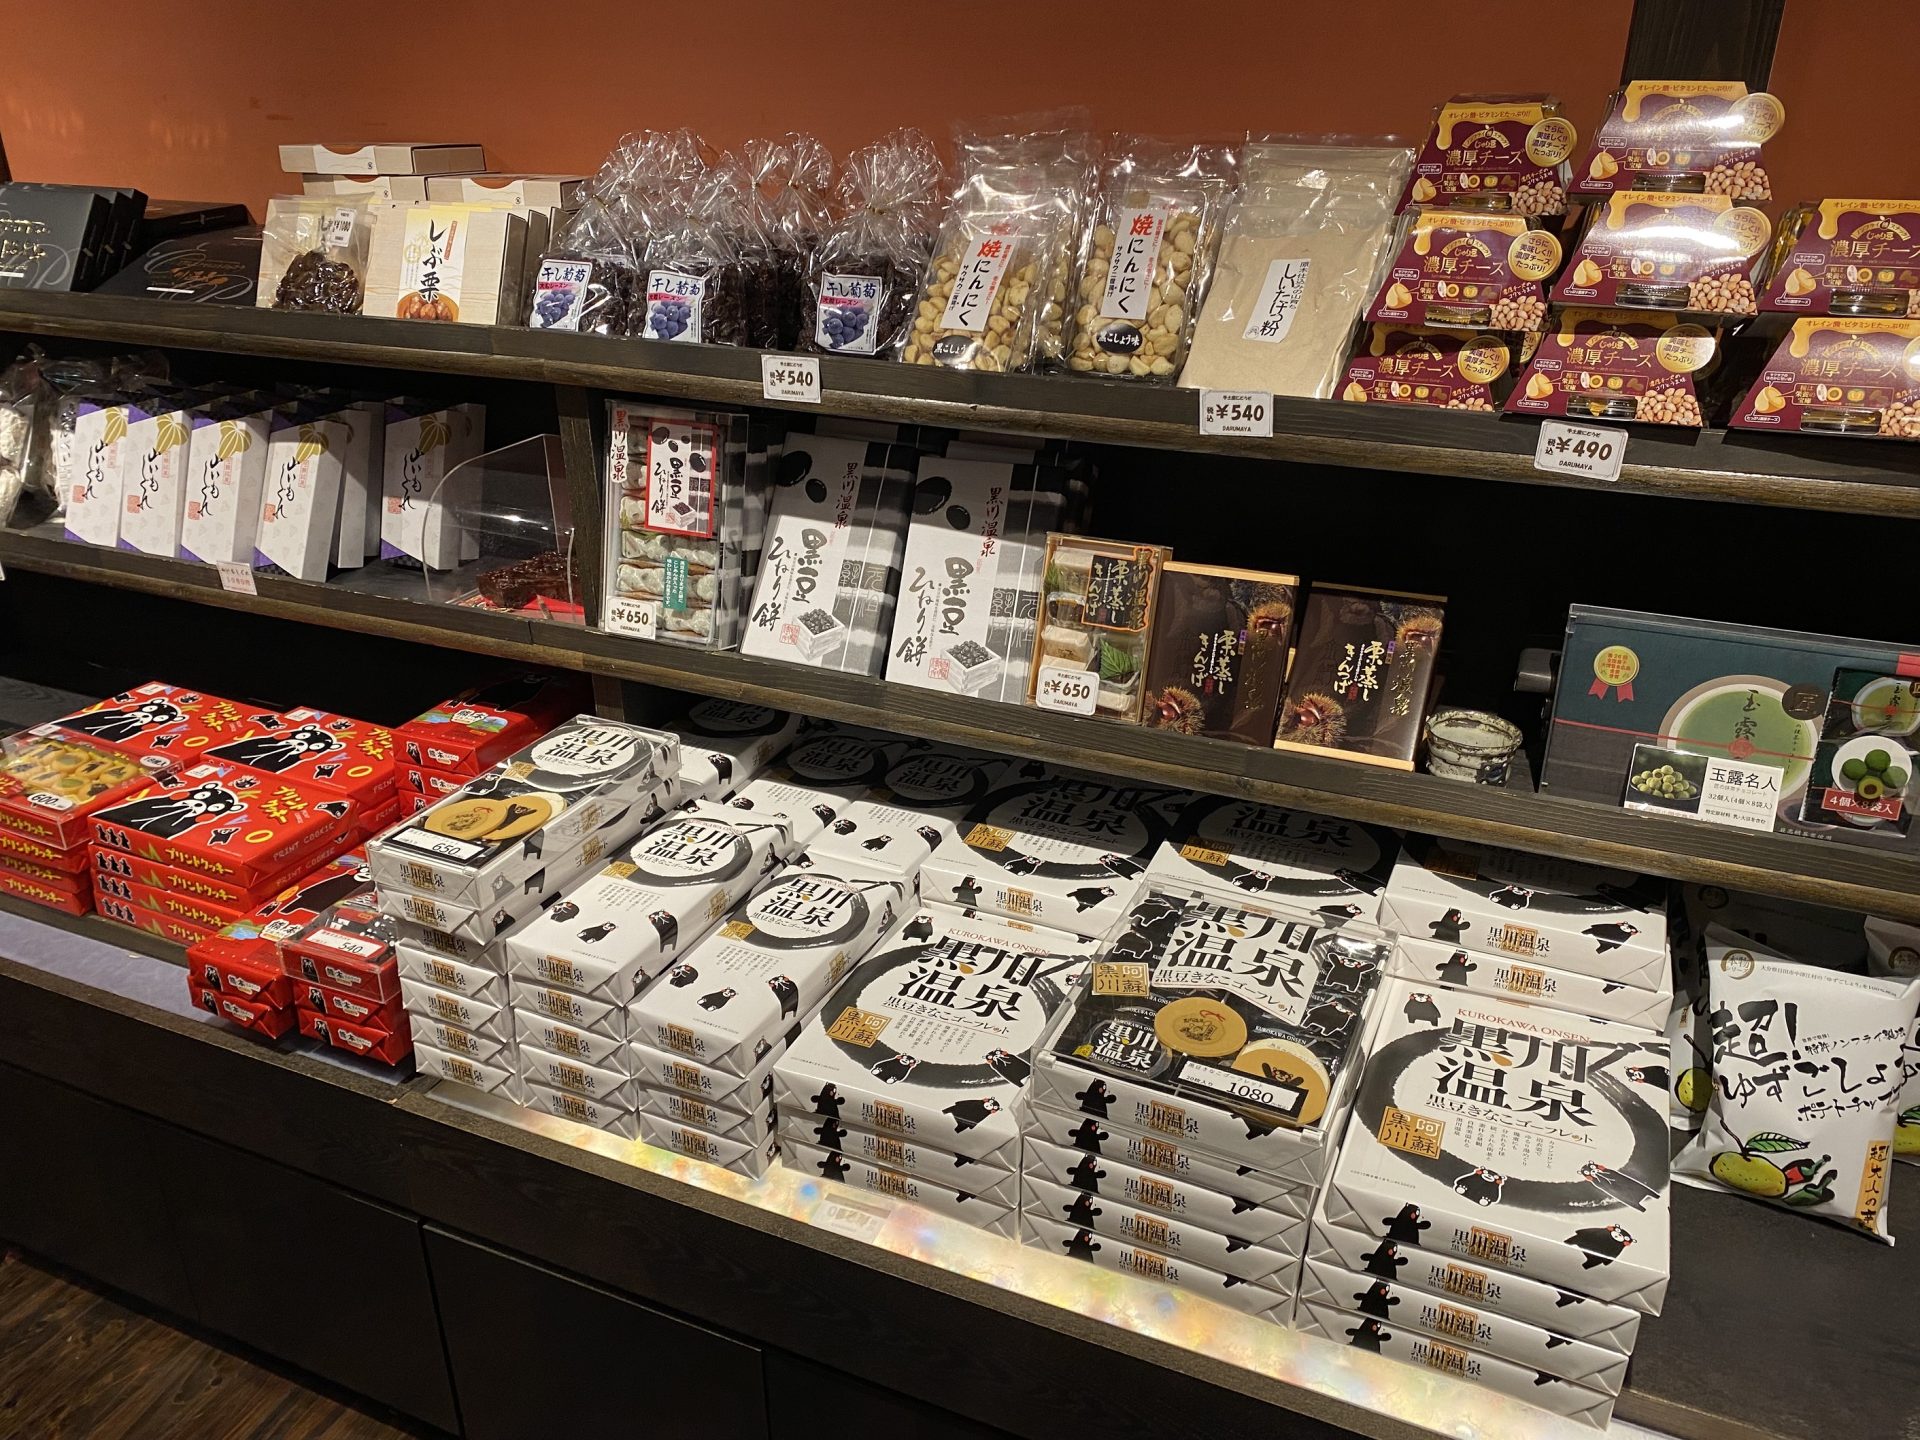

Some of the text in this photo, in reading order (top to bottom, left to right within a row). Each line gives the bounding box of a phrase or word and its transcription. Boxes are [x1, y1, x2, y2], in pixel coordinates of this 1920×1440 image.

[1445, 149, 1526, 168] 濃厚チーズ
[1423, 256, 1507, 277] 濃厚チーズ
[1378, 357, 1457, 379] 濃厚チーズ
[1566, 346, 1655, 369] 濃厚チーズ
[1801, 359, 1898, 380] 濃厚チーズ
[775, 369, 813, 387] ¥540
[1215, 404, 1265, 421] ¥540
[1555, 435, 1613, 461] ¥490
[1558, 460, 1594, 471] DARUMAYA
[791, 527, 828, 604] 黒豆
[937, 556, 975, 636] 黒豆
[616, 607, 649, 626] ¥650
[1050, 679, 1090, 700] ¥650
[544, 741, 618, 766] 温泉
[1709, 766, 1778, 793] 玉露名人
[432, 842, 461, 855] 650
[662, 822, 739, 850] 黒川
[643, 838, 719, 867] 温泉
[776, 878, 855, 909] 黒川
[760, 895, 836, 928] 温泉
[948, 926, 1051, 957] KUROKAWA ONSEN
[1180, 900, 1318, 955] 黒川
[916, 934, 1045, 987] 黒川
[1168, 928, 1306, 1000] 温泉
[898, 966, 1024, 1022] 温泉
[1154, 967, 1297, 1017] 黒豆きなこゴーフレット
[1457, 1007, 1591, 1044] KUROKAWA ONSEN
[1094, 1036, 1151, 1070] 温泉
[1438, 1016, 1590, 1083] 黒川
[1226, 1081, 1275, 1104] 1080
[1432, 1056, 1599, 1128] 温泉
[1425, 1093, 1594, 1145] 黒豆きなこゴーフレット
